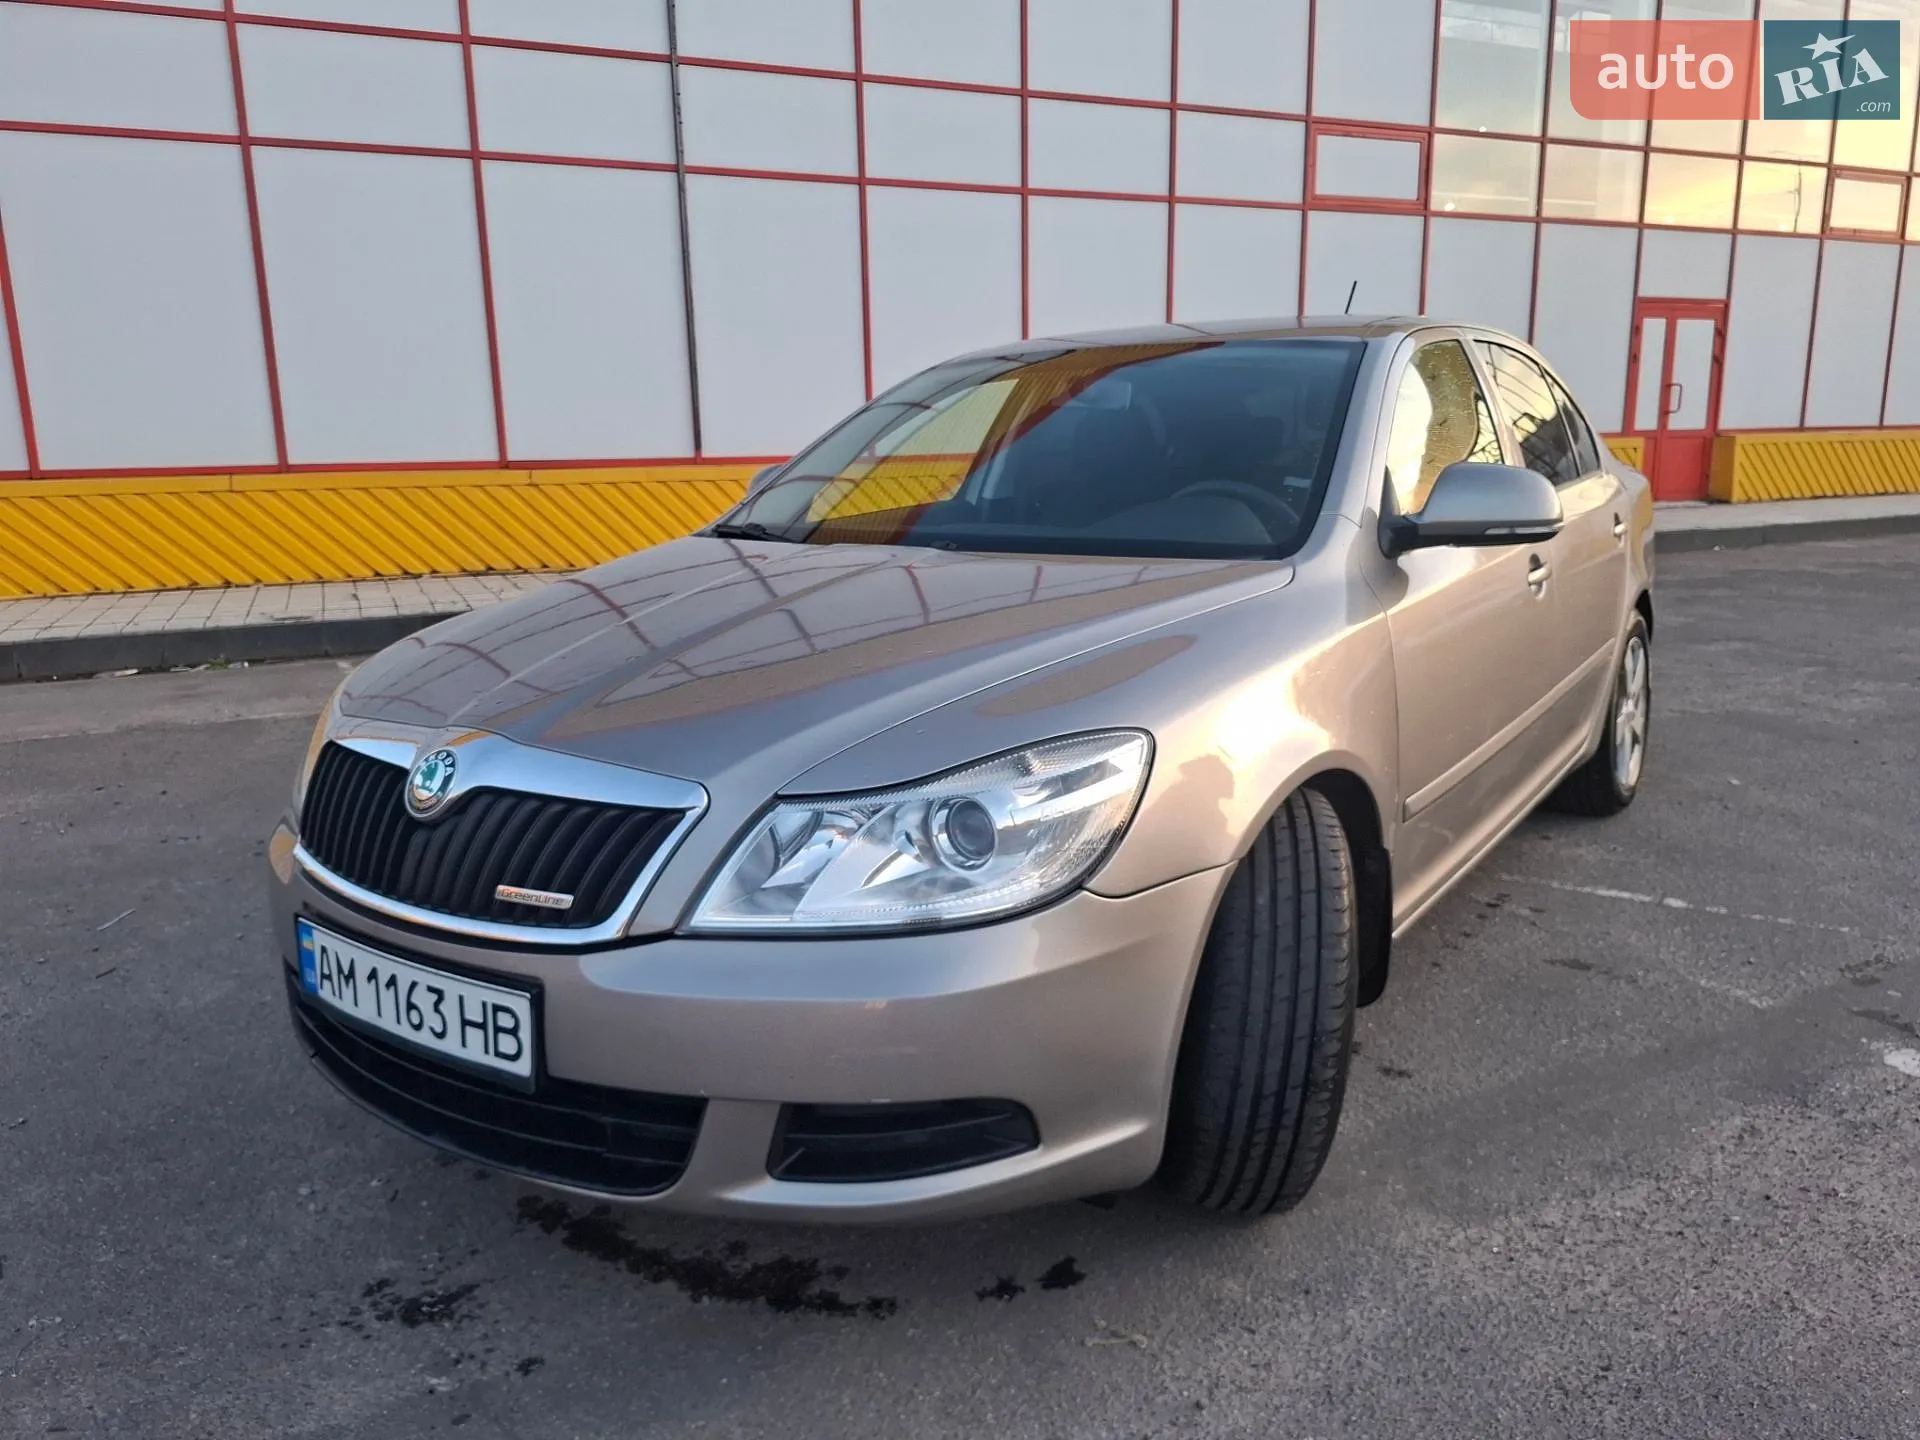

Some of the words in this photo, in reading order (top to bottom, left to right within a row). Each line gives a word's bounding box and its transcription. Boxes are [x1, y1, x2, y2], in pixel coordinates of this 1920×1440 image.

[320, 944, 358, 1008] AM
[367, 966, 447, 1040] 1163
[458, 993, 523, 1062] HB
